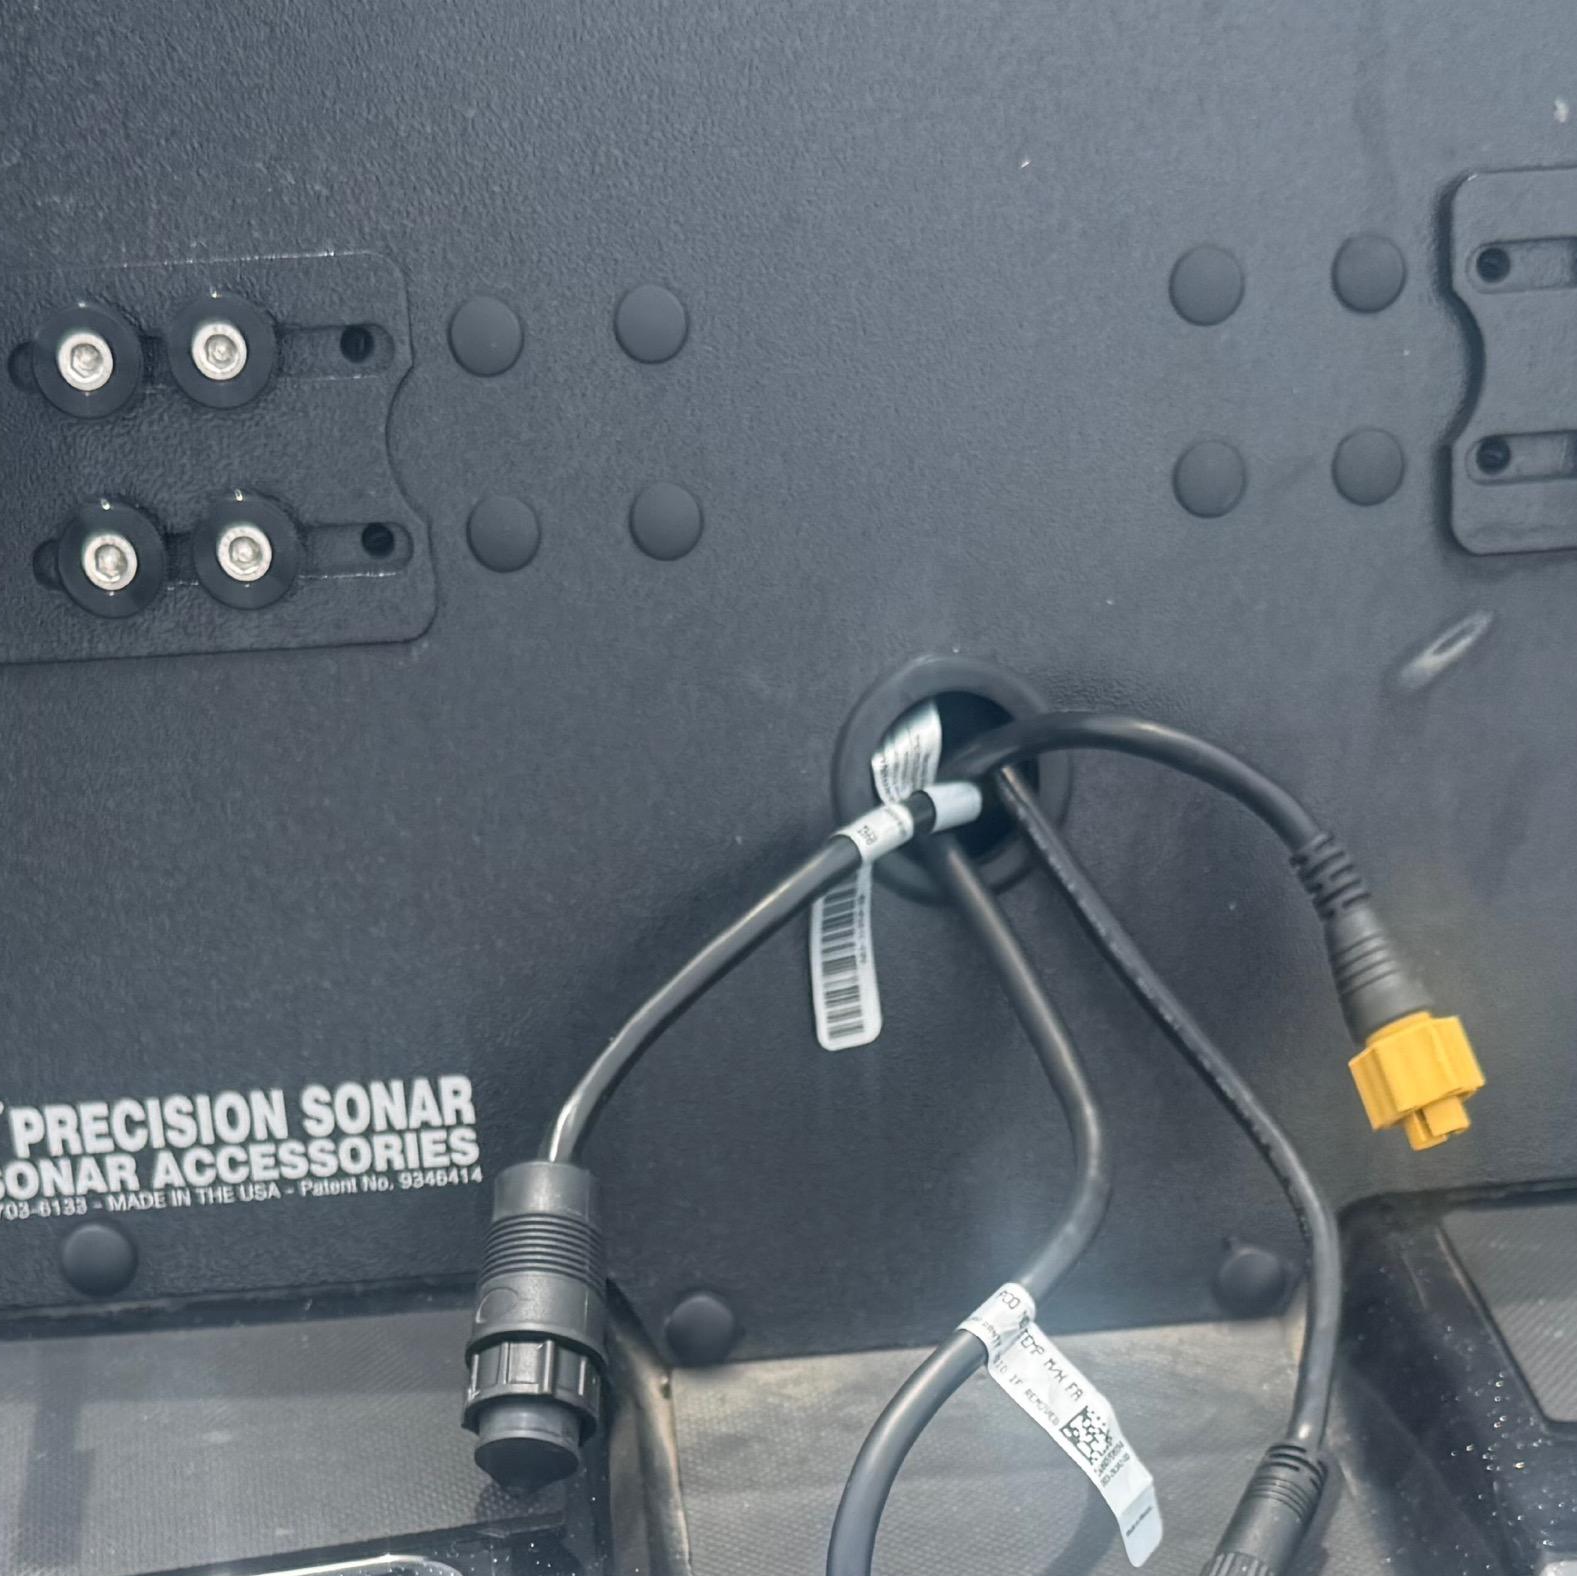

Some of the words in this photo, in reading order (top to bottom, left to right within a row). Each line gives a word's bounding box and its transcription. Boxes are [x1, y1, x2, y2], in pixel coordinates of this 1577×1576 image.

[8, 1088, 288, 1158] PRECISION
[302, 1074, 475, 1135] SONAR
[152, 1128, 480, 1189] ACCESSORIES
[106, 1190, 167, 1211] MADE
[171, 1187, 191, 1207] IN
[195, 1183, 235, 1205] THE
[239, 1180, 281, 1201] USA
[300, 1176, 358, 1197] Patent
